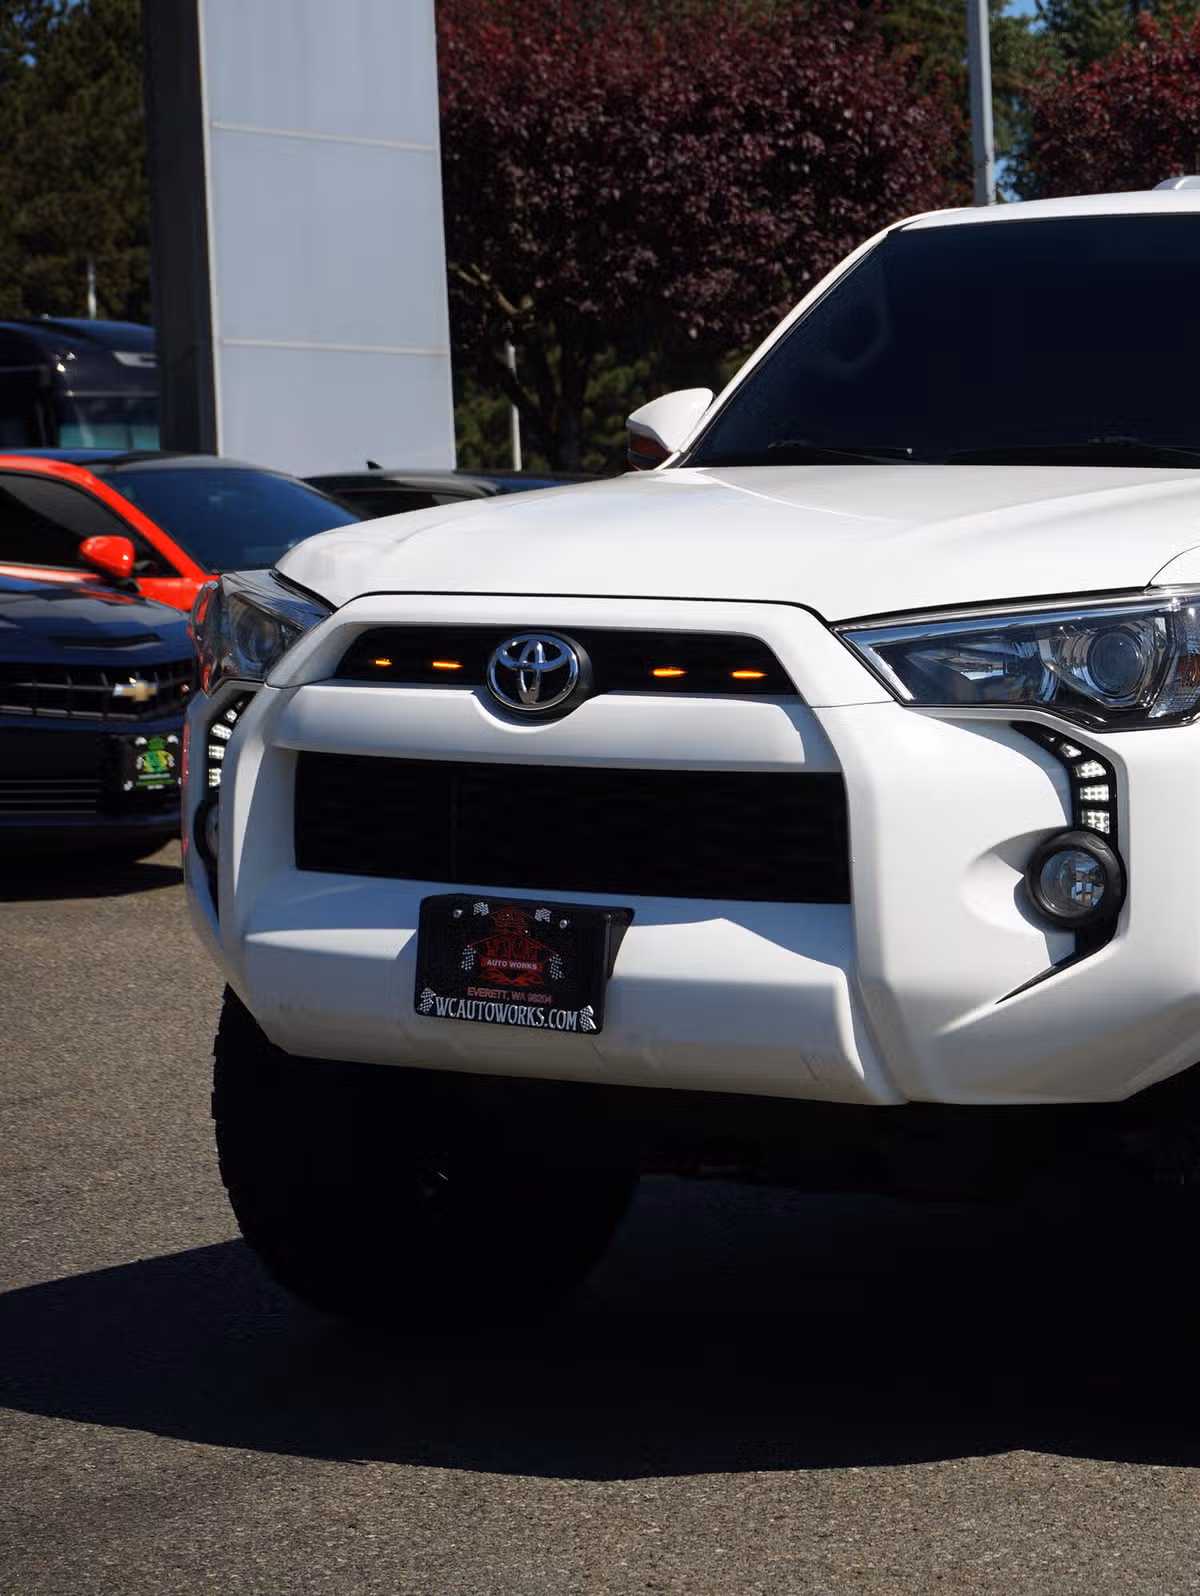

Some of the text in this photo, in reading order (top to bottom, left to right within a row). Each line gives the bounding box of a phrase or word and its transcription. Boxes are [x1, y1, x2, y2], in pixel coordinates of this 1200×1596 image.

[486, 959, 538, 970] AUTO WORKS
[467, 986, 510, 1000] EVERETT,
[511, 991, 527, 1002] WA
[435, 996, 578, 1031] WCAUTOWORKS.COM
